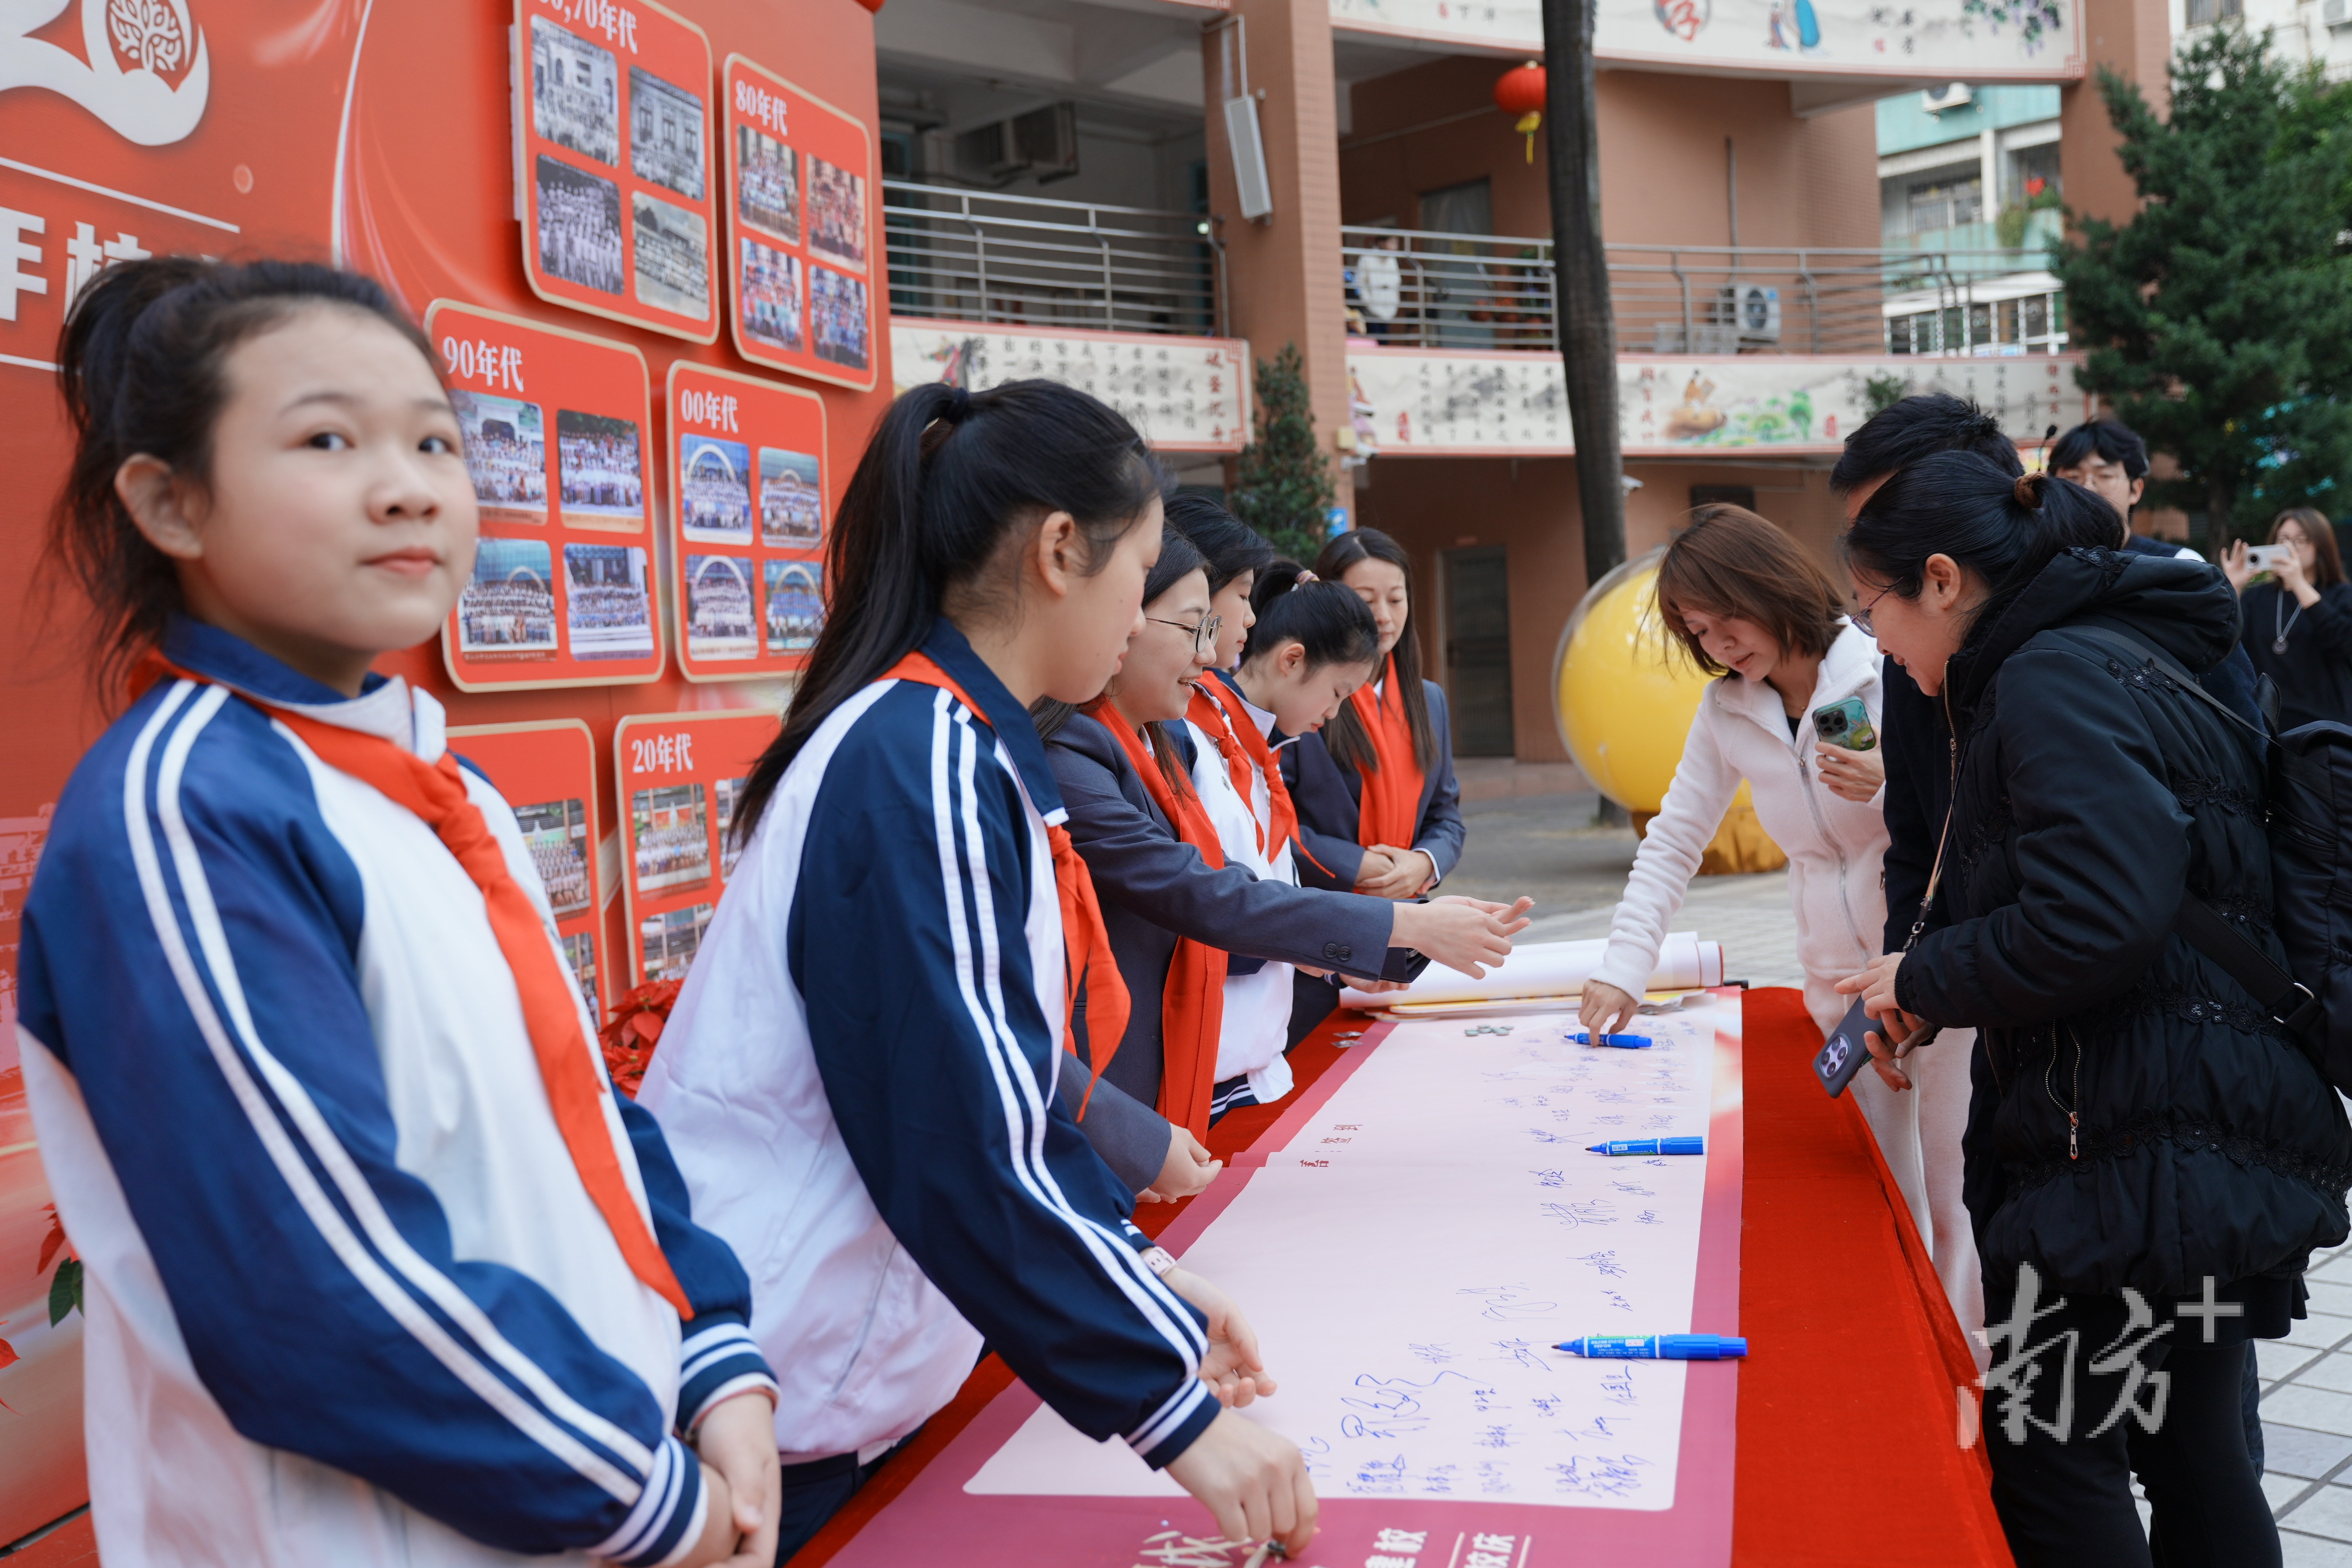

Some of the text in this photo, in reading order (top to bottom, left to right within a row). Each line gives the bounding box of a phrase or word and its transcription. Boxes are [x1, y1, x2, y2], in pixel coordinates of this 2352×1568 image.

[539, 0, 639, 55] ,70年代
[735, 80, 788, 136] 80年代
[443, 336, 524, 392] 90年代
[681, 390, 739, 433] 00年代
[632, 733, 694, 774] 20年代
